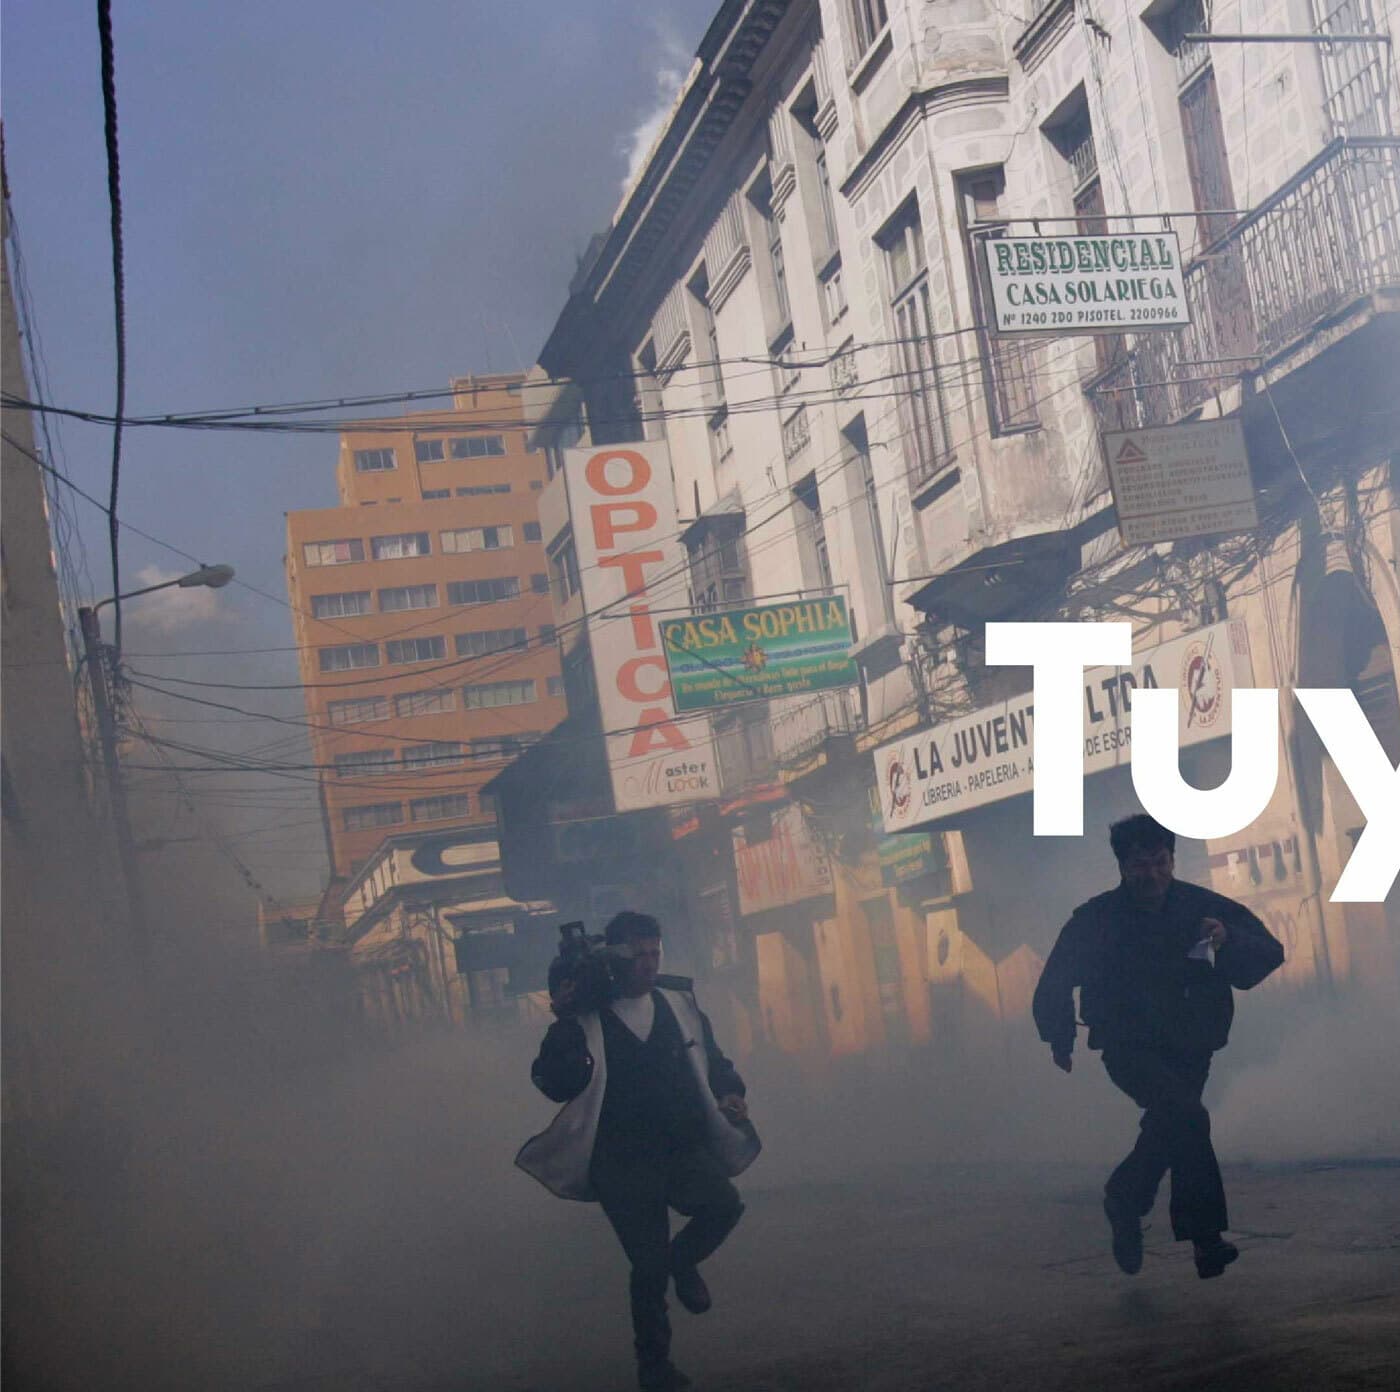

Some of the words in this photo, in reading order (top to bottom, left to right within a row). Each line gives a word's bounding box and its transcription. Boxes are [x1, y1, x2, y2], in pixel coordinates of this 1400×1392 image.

[994, 237, 1174, 276] RESIDENCIAL
[1007, 282, 1061, 306] CASA
[1064, 276, 1178, 305] SOLARIEGA
[1020, 311, 1047, 325] 1240
[1130, 306, 1178, 321] 2200966
[584, 449, 690, 757] OPTICA
[665, 616, 739, 652] CASA
[743, 600, 845, 641] SOPHIA
[913, 740, 944, 780] LA
[922, 780, 962, 807] LIBRERIA
[968, 762, 1019, 791] PAPELERIA
[1087, 738, 1102, 757] DE
